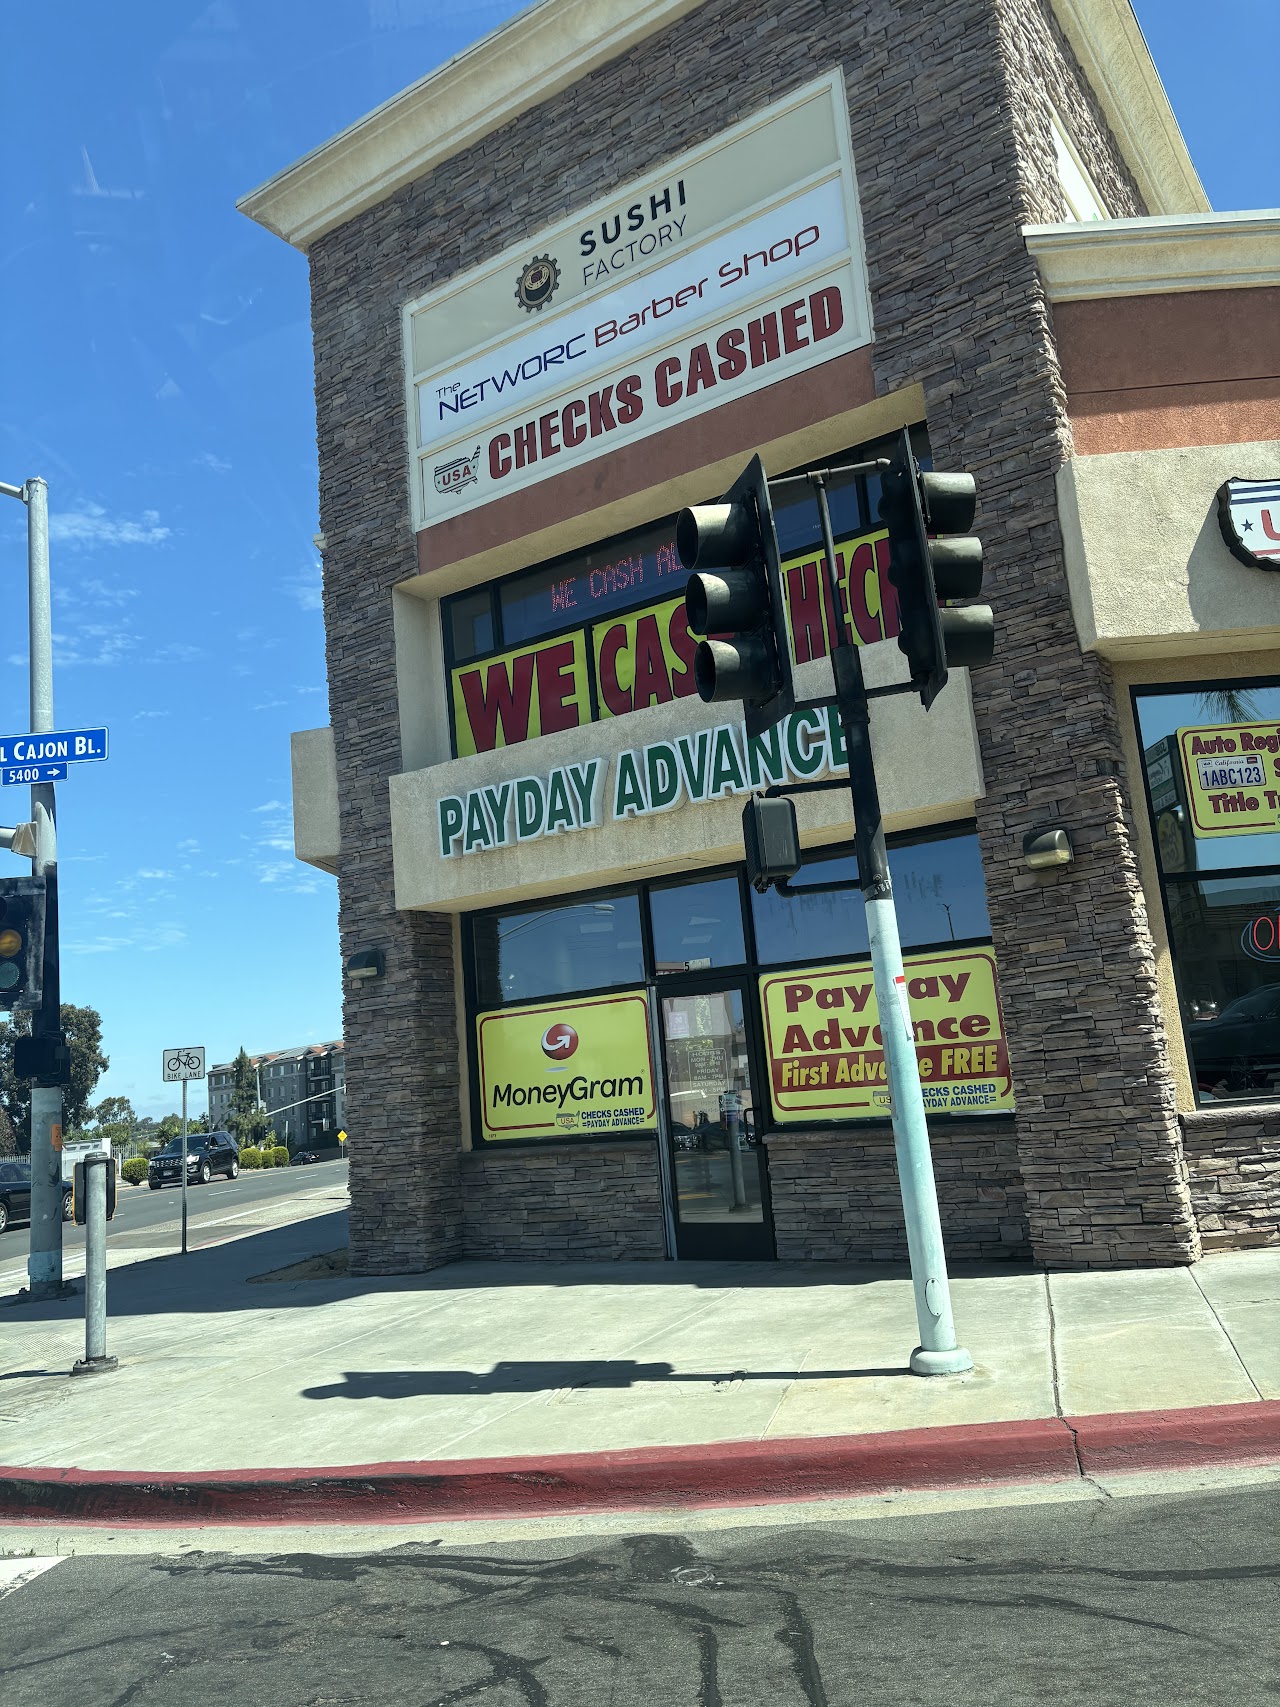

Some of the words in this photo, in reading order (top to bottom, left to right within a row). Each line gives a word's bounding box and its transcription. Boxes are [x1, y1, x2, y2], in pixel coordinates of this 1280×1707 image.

[580, 179, 686, 257] SUSHI
[583, 214, 687, 286] FACTORY
[438, 333, 586, 421] NETWORC
[594, 277, 709, 348] Barber
[718, 225, 820, 289] Shop
[435, 381, 461, 399] The
[488, 374, 644, 480] CHECKS
[654, 285, 844, 408] CASHED
[441, 463, 473, 487] USA
[551, 576, 578, 613] WE
[589, 553, 644, 599] CASH
[459, 640, 581, 754] WE
[13, 741, 68, 761] CAJON
[75, 736, 102, 756] BL.
[1191, 735, 1238, 756] Auto
[8, 767, 40, 783] 5400
[438, 757, 609, 859] PAYDAY
[613, 704, 851, 821] ADVANCE
[1202, 766, 1262, 787] 1ABC123
[1208, 791, 1260, 814] Title
[784, 971, 972, 1014] Payay
[167, 1072, 182, 1080] BIKE
[184, 1070, 201, 1078] LANE
[781, 1058, 830, 1088] First
[941, 1044, 999, 1076] FREE
[492, 1075, 644, 1109] MoneyGram
[952, 1082, 997, 1096] CASHED
[559, 1117, 575, 1125] USA
[581, 1109, 613, 1120] CHECKS
[613, 1107, 646, 1118] CASHED
